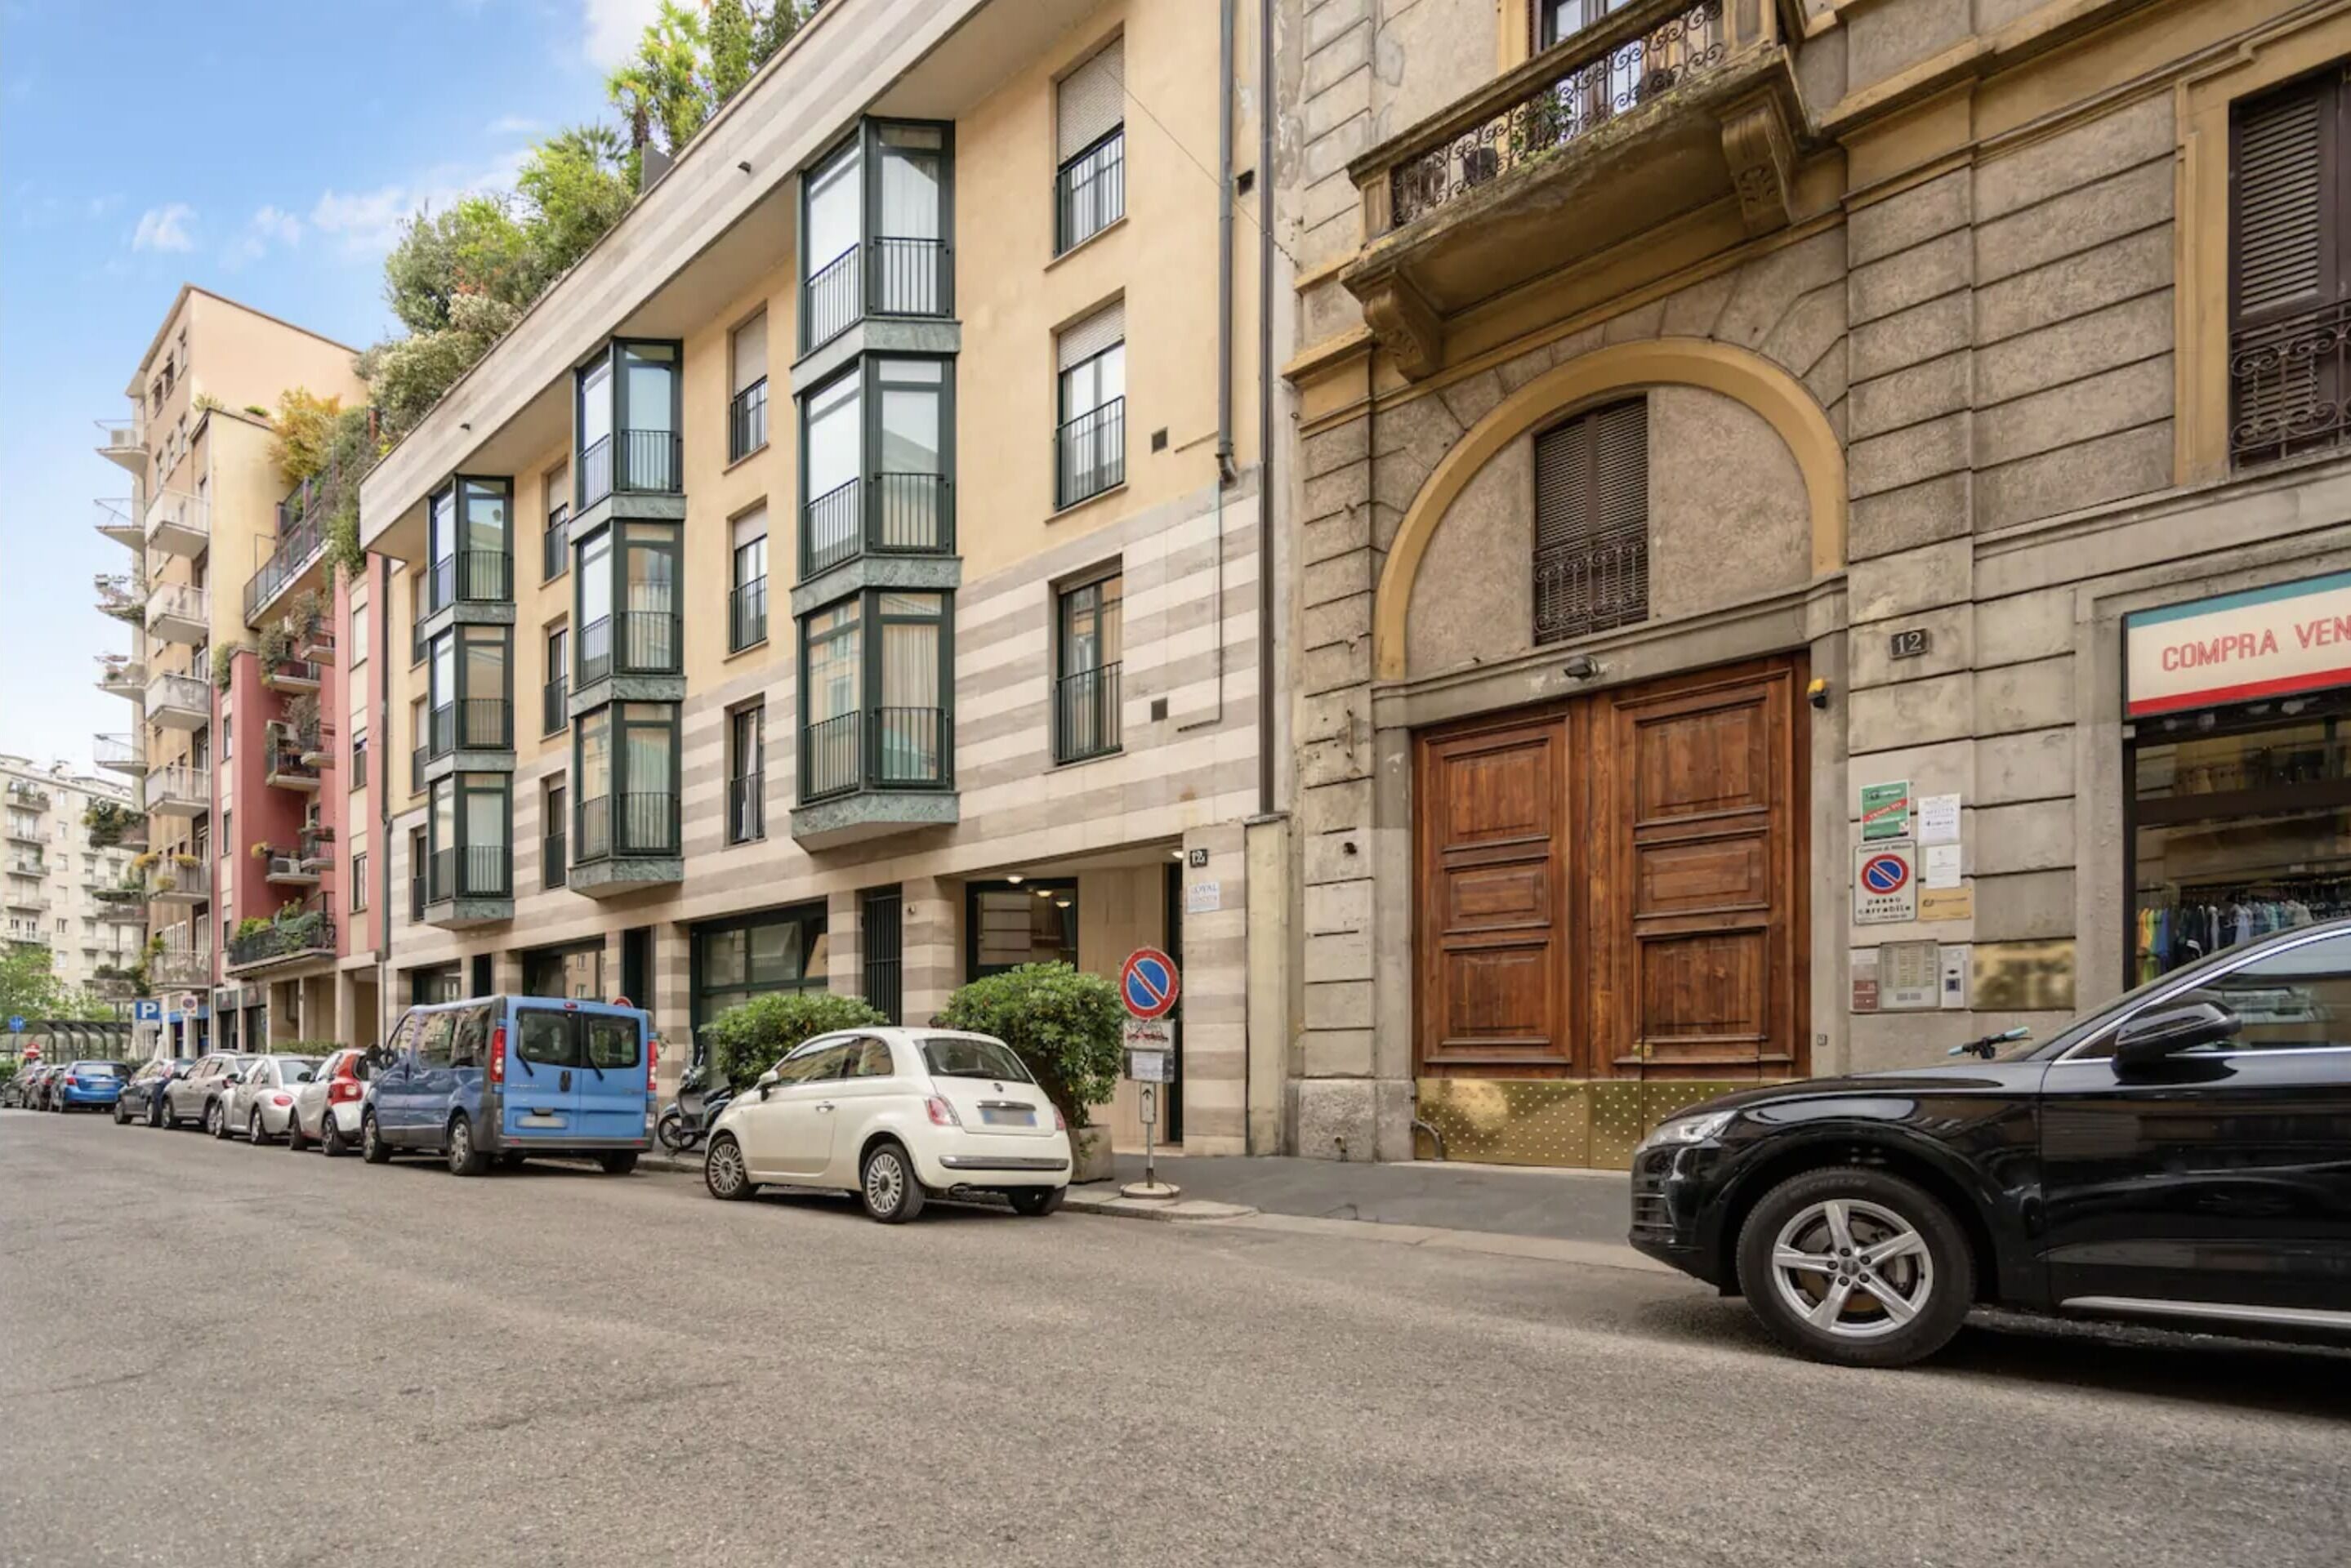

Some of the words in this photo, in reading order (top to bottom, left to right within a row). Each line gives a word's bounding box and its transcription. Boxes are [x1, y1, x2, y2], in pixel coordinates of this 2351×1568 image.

[1898, 631, 1921, 654] 12
[2162, 628, 2279, 671] COMPRA
[2294, 615, 2351, 649] VEN
[1858, 904, 1911, 914] carrabile
[1867, 897, 1901, 906] passo
[141, 1002, 157, 1018] P
